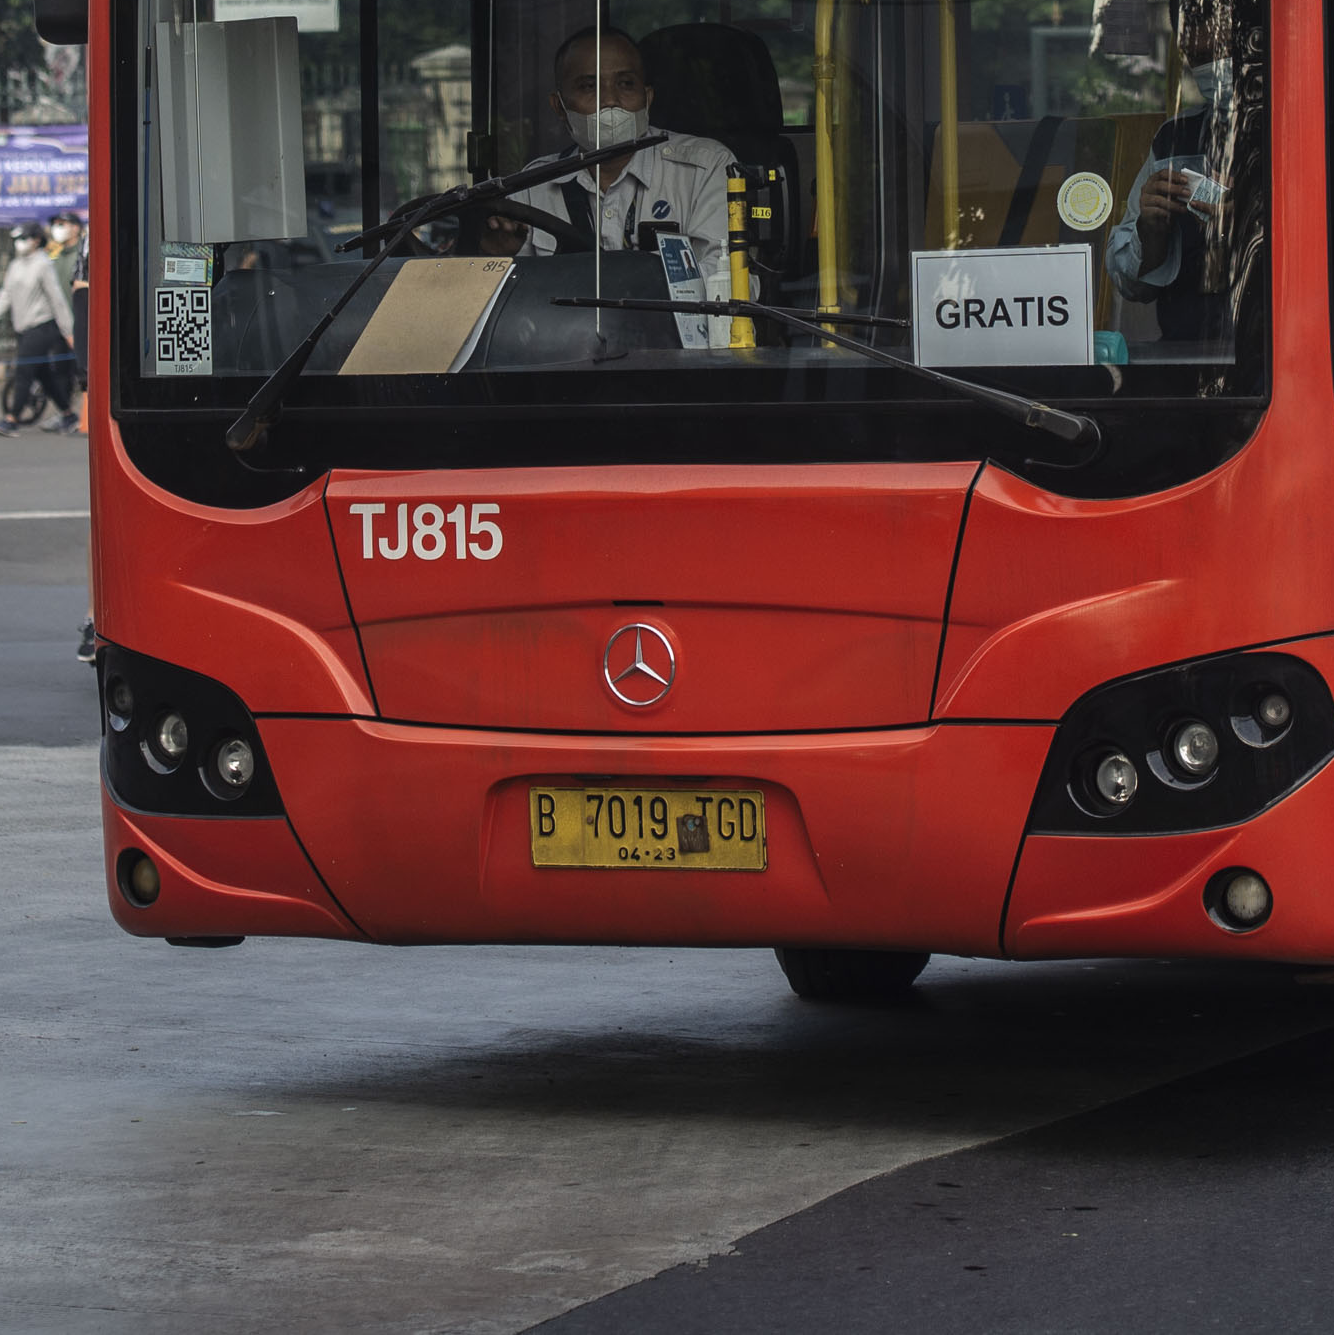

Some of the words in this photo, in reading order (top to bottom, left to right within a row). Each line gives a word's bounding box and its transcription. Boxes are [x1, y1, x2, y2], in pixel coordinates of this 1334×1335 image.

[482, 260, 509, 273] 815
[935, 295, 1070, 330] GRATIS
[174, 364, 194, 374] TJ815
[349, 502, 504, 561] TJ815
[537, 793, 556, 837] B
[586, 794, 669, 840] 7019
[695, 796, 757, 841] TGD
